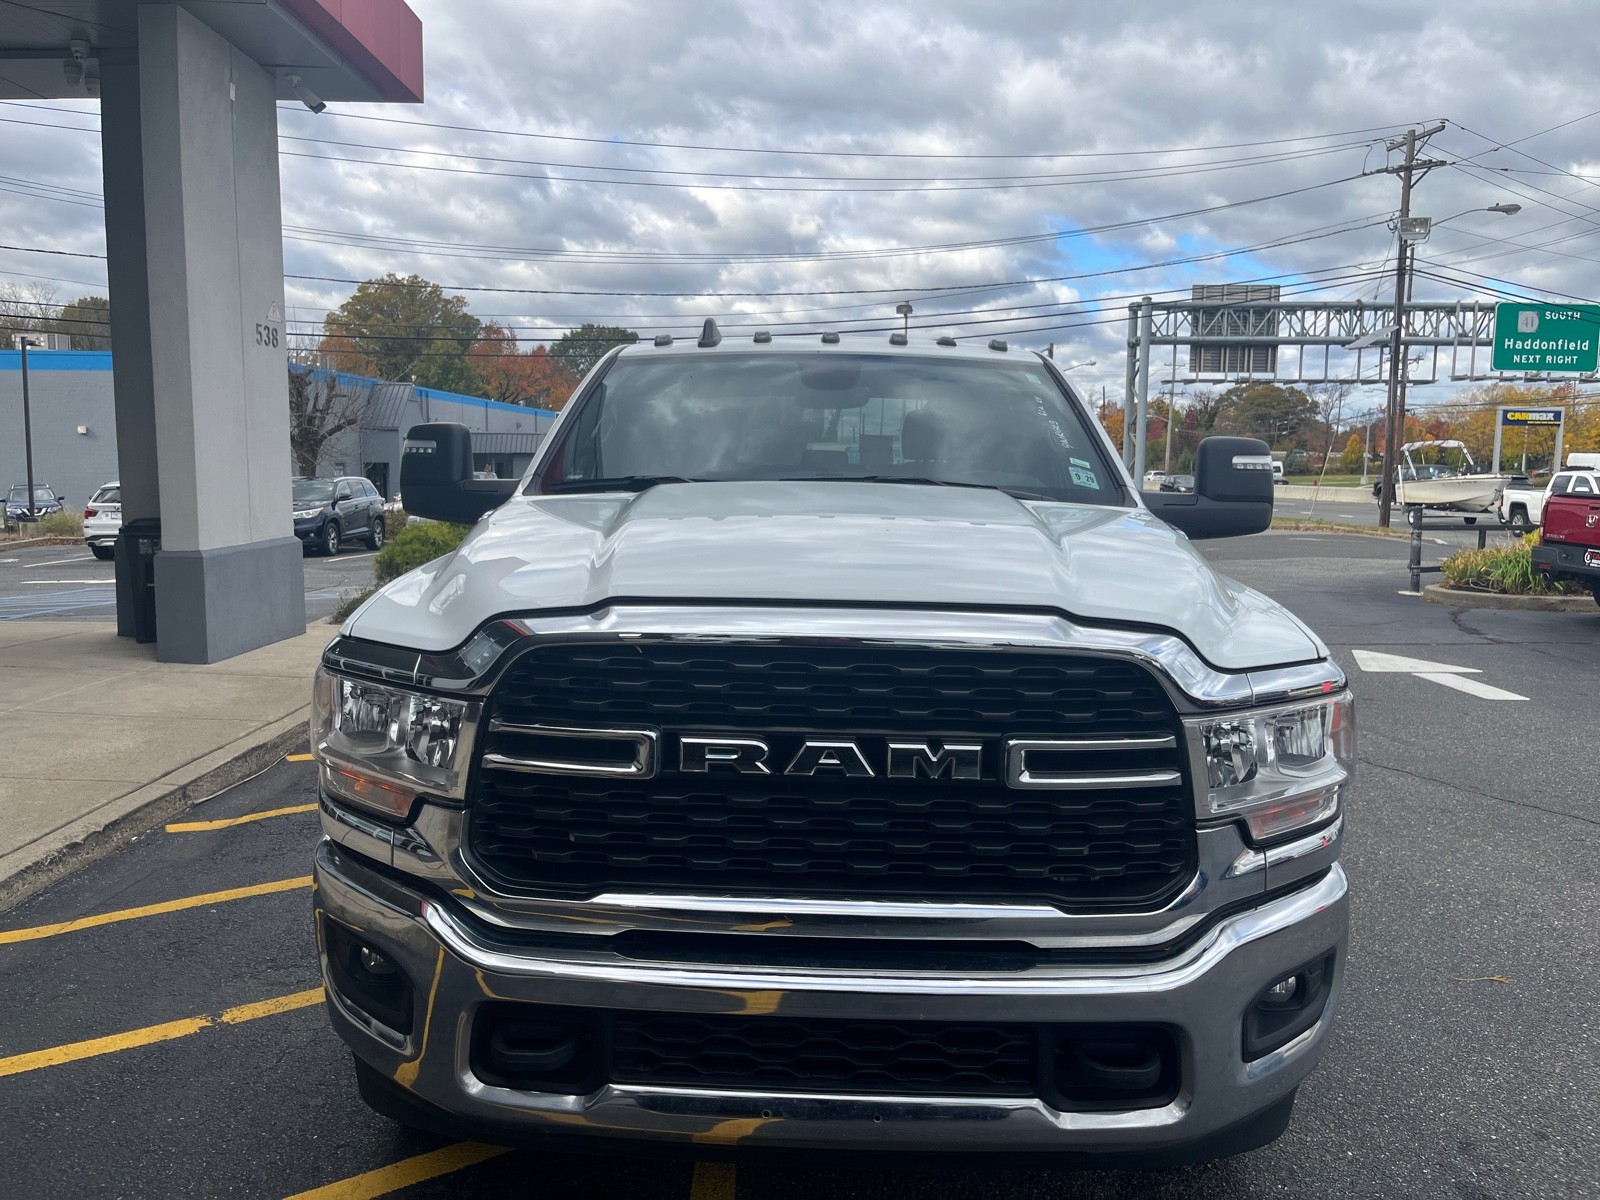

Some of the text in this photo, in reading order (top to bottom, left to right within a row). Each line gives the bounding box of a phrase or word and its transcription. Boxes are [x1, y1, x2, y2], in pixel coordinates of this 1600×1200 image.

[1545, 311, 1580, 320] SOUTH
[1522, 316, 1534, 328] 41
[255, 322, 279, 349] 538
[1504, 338, 1589, 350] Haddonfield
[1513, 355, 1578, 364] NEXT RIGHT
[679, 734, 984, 780] RAM
